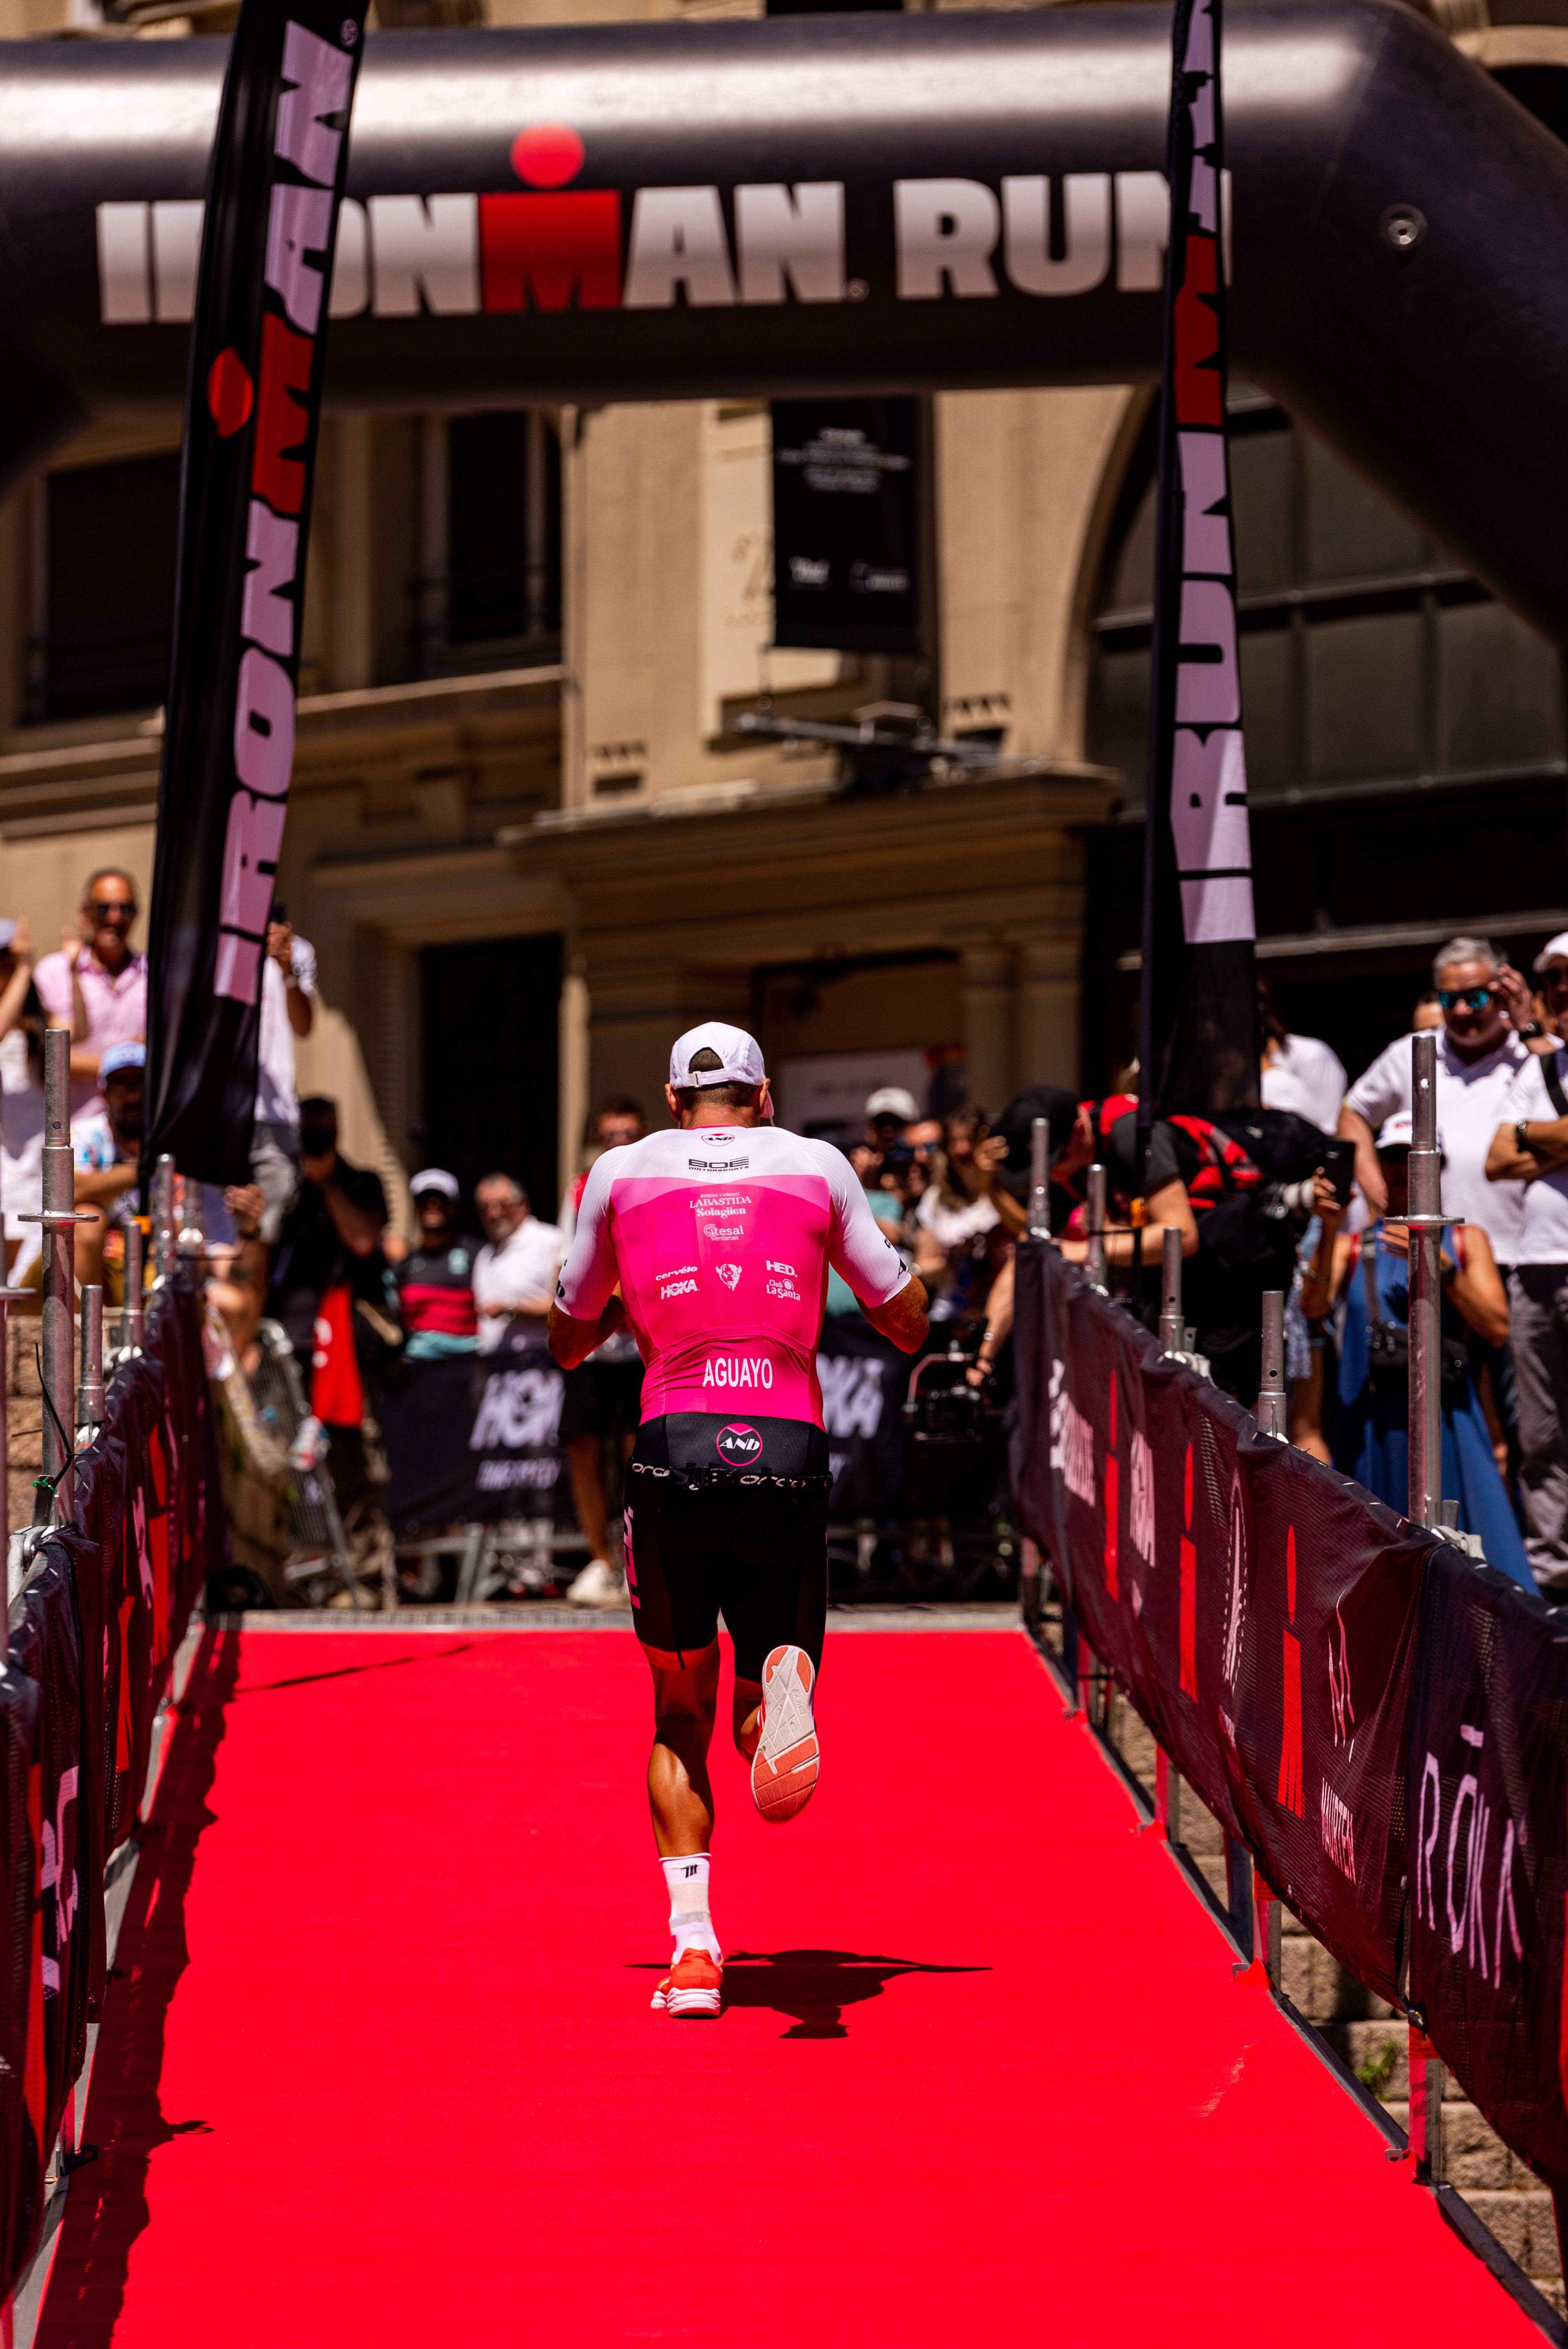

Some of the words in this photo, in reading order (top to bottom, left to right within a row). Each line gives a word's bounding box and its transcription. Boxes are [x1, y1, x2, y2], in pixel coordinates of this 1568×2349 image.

[690, 1196, 752, 1209] LABASTIDA
[697, 1207, 746, 1219] Solagüen
[655, 1265, 698, 1281] cervélo
[661, 1279, 698, 1300] HOKA
[769, 1279, 783, 1288] Club
[702, 1357, 773, 1389] AGUAYO
